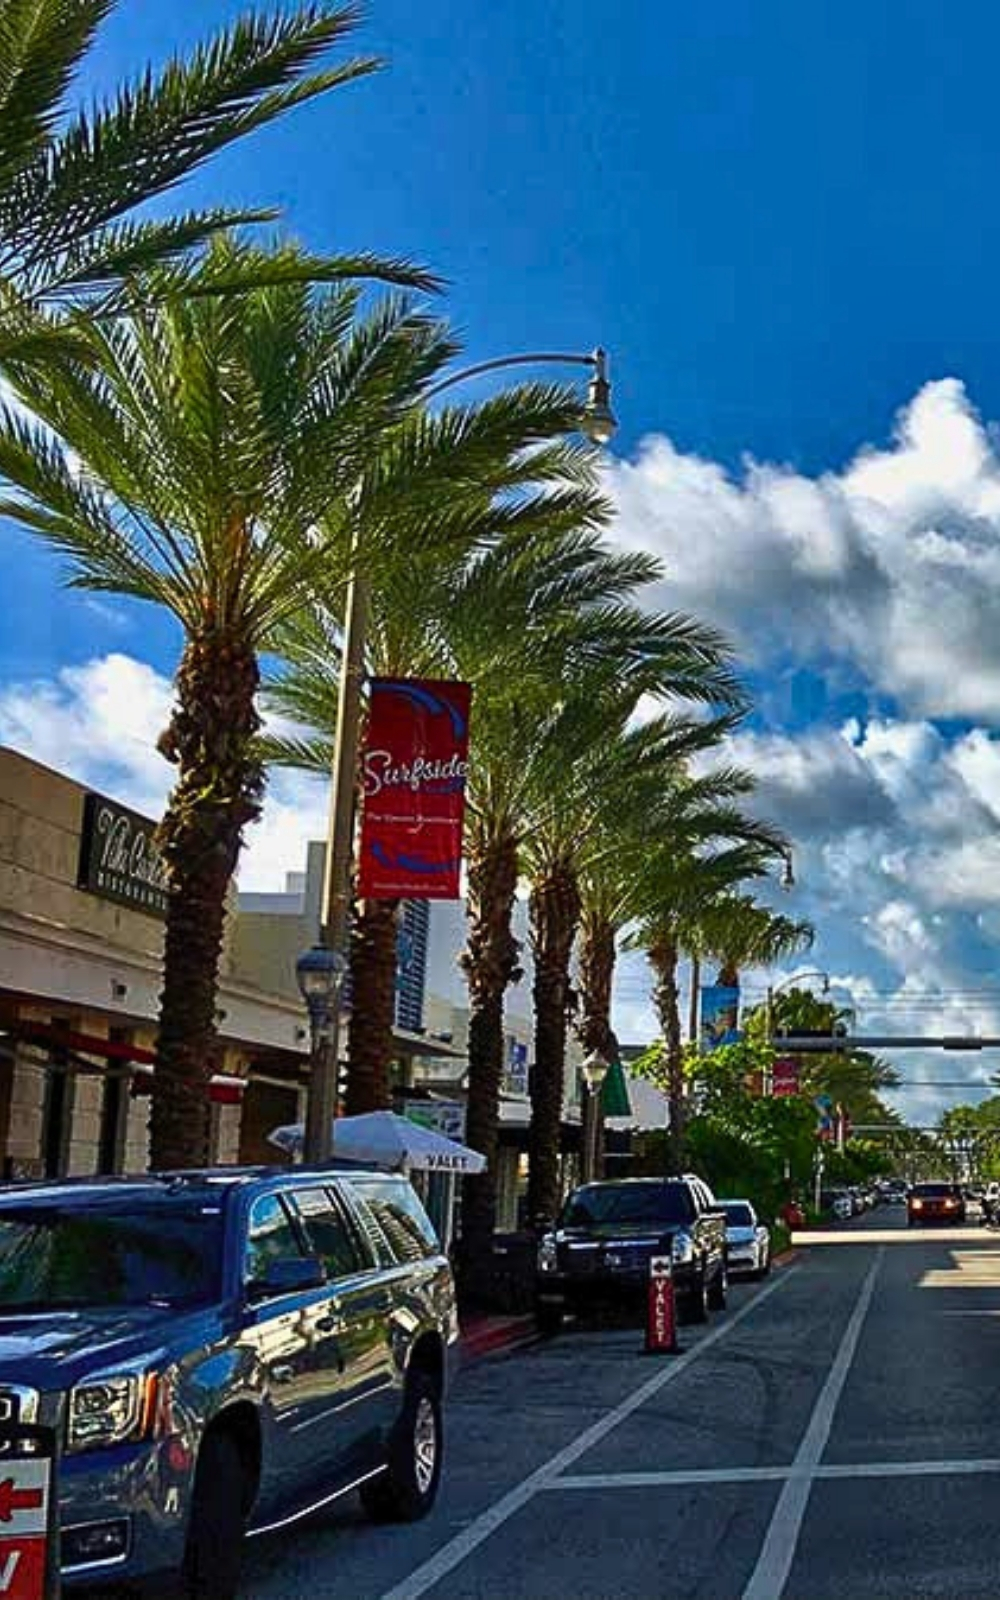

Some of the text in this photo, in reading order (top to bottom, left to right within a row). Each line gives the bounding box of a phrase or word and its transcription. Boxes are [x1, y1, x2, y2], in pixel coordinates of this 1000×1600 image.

[364, 750, 470, 796] Surfside
[427, 1153, 468, 1170] VALET
[655, 1278, 667, 1343] VALET
